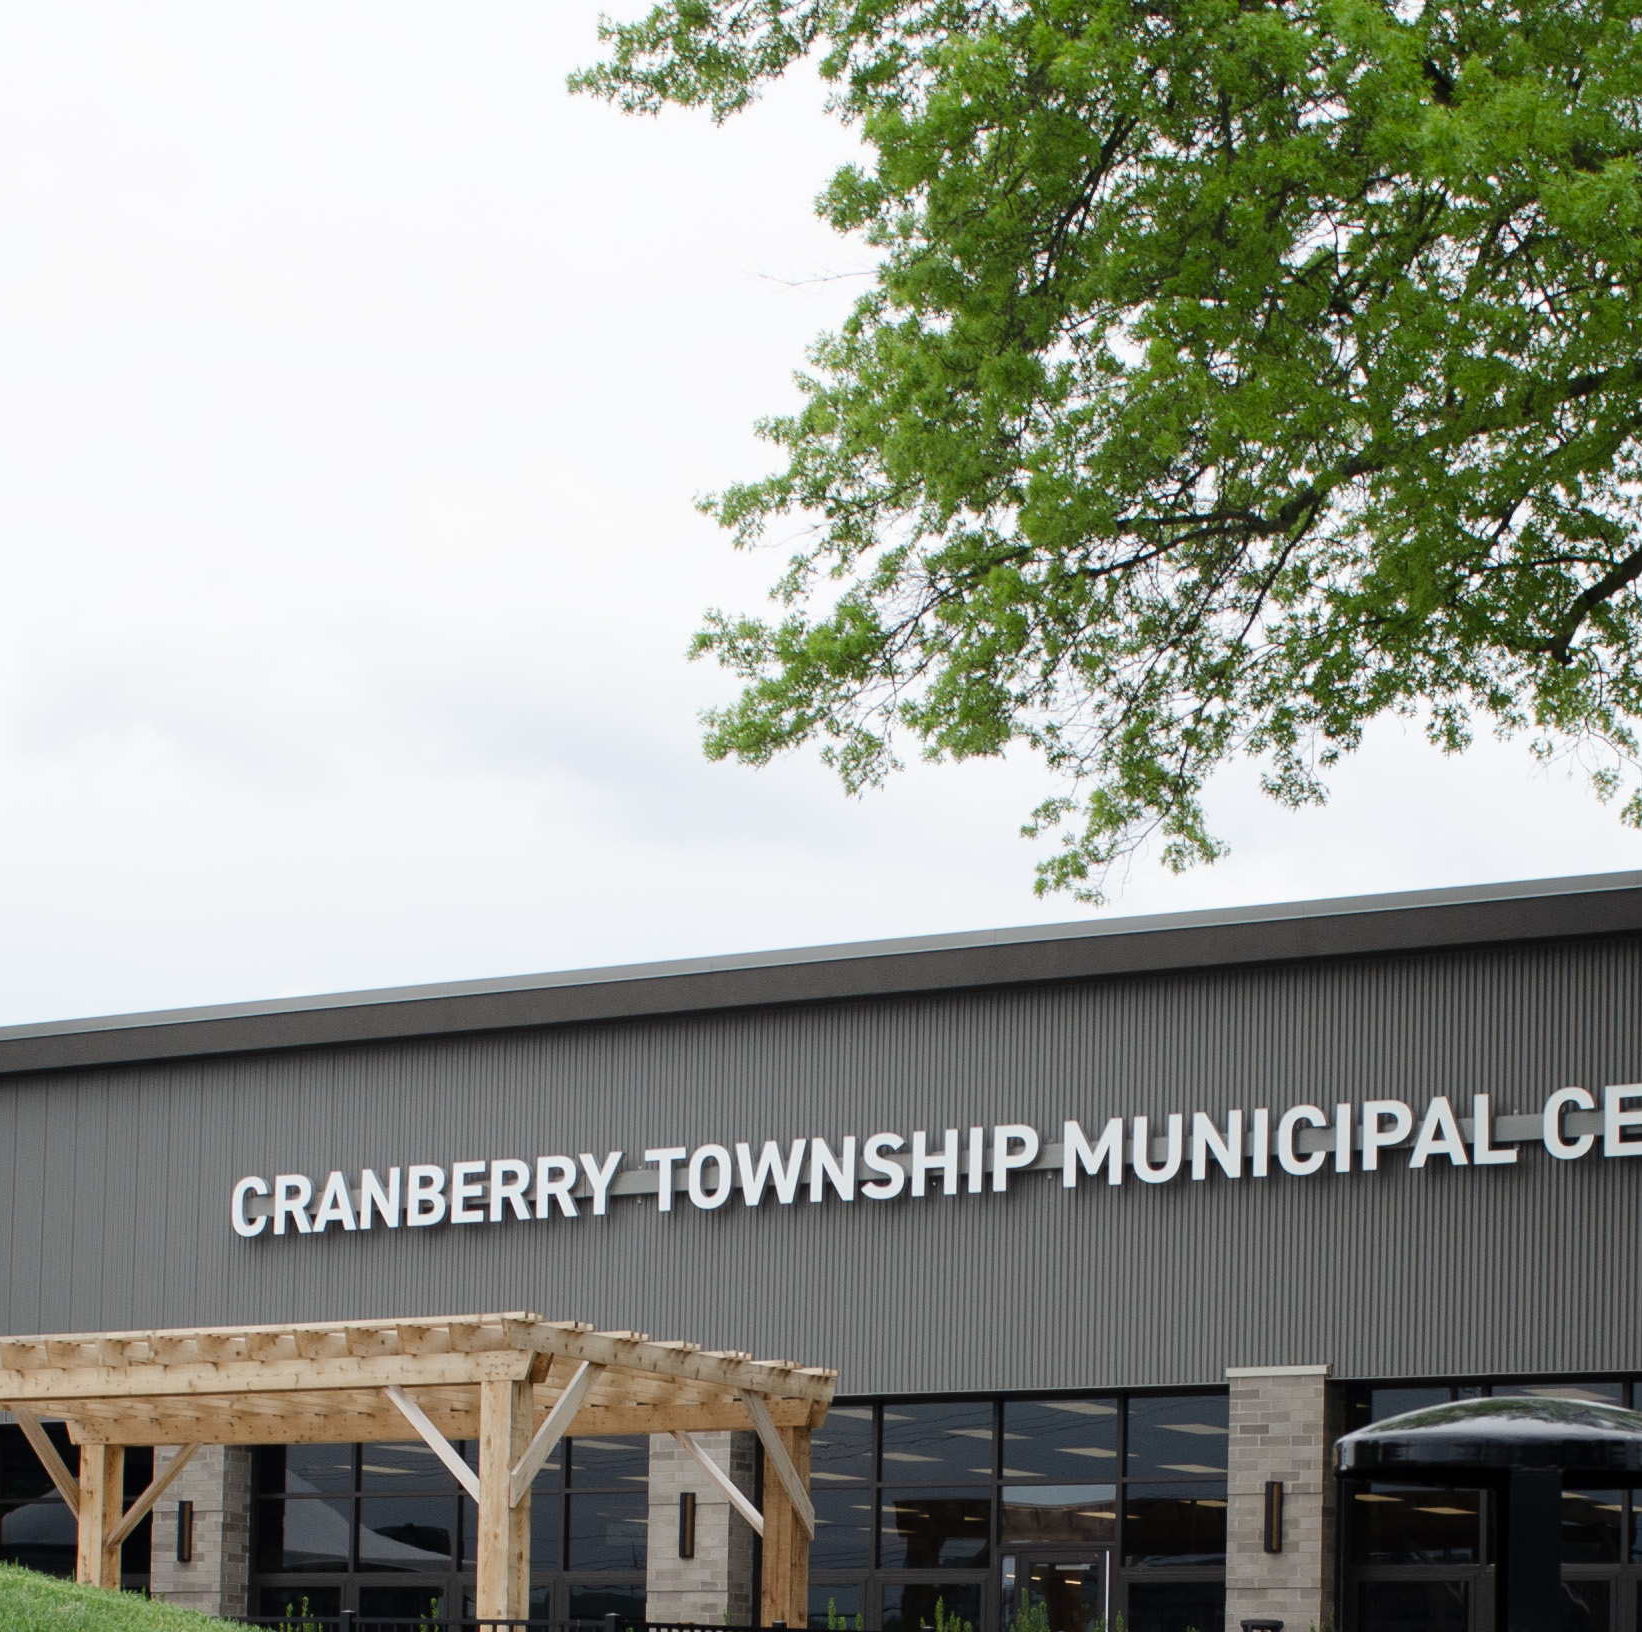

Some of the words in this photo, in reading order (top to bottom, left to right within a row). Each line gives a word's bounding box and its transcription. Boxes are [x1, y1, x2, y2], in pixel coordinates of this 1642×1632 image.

[230, 1149, 624, 1238] CRANBERRY
[643, 1123, 1040, 1213] TOWNSHIP
[1061, 1092, 1518, 1189] MUNICIPAL
